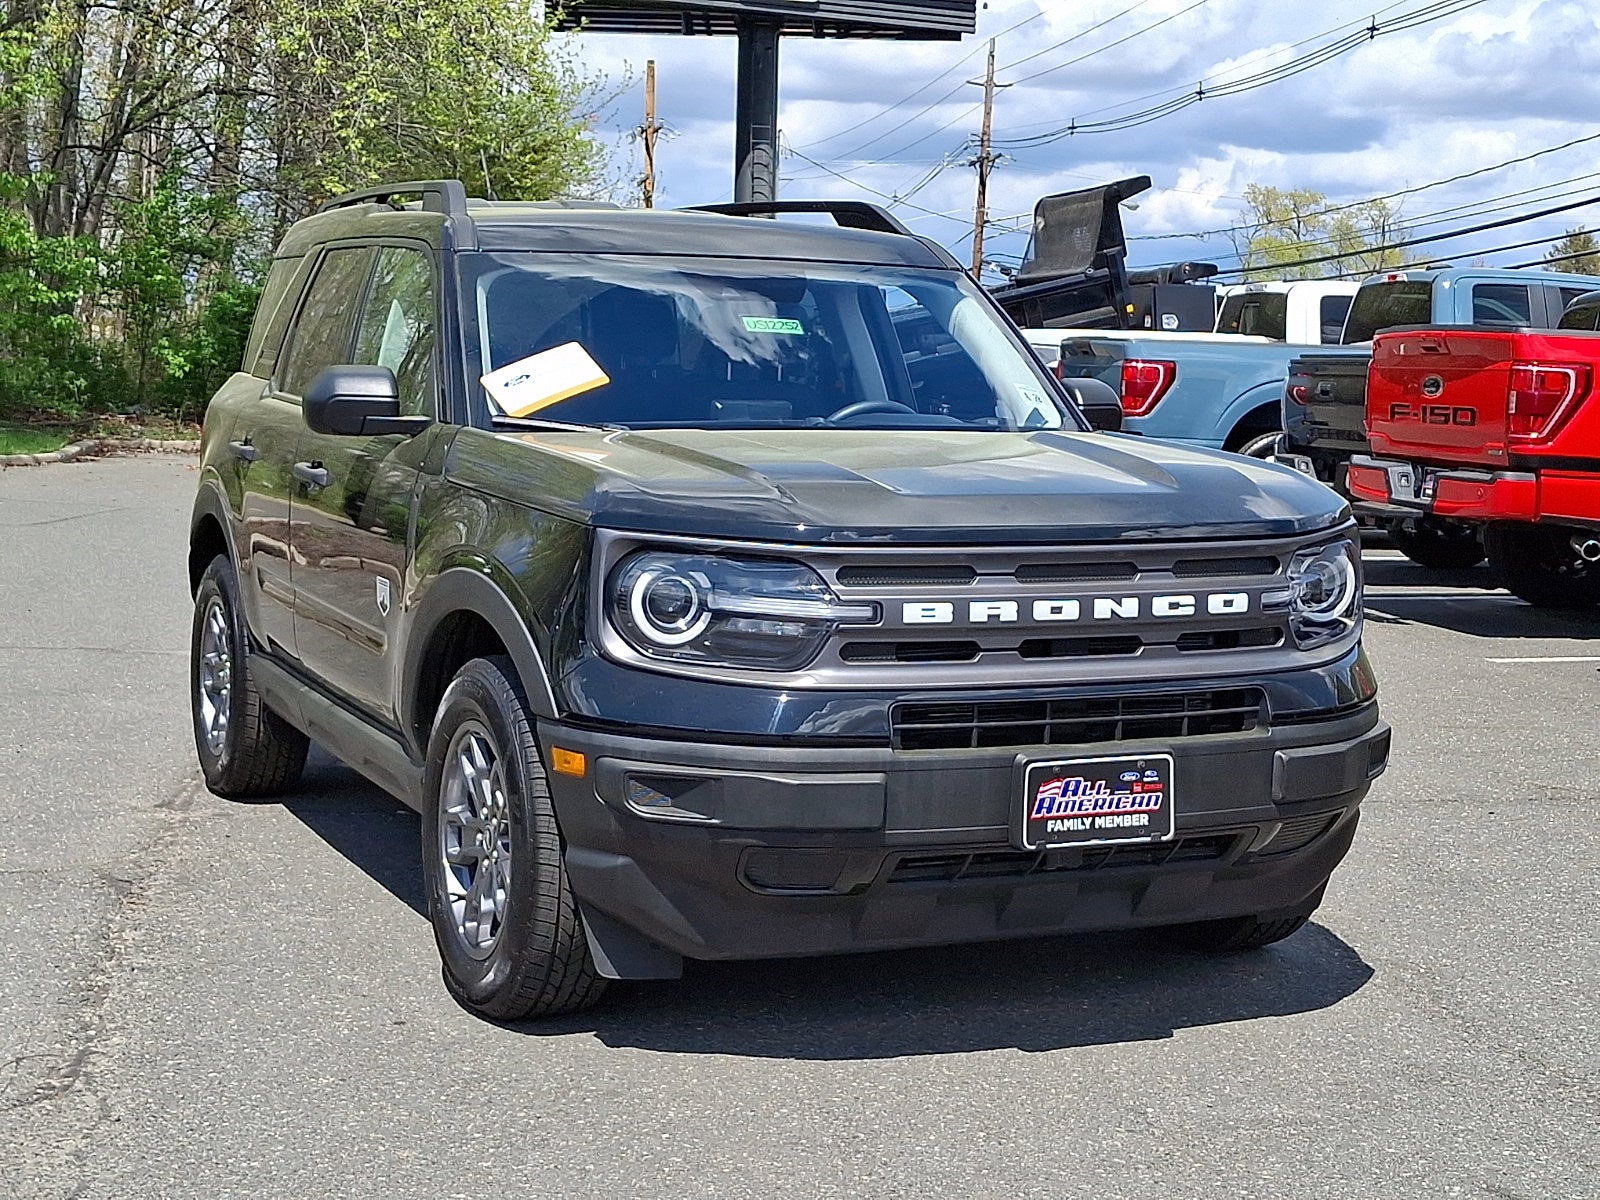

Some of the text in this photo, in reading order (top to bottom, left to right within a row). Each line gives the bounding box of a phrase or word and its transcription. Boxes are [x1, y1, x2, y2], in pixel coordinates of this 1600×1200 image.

[1389, 402, 1477, 427] F-150
[902, 592, 1249, 624] BRONCO
[1059, 777, 1111, 798] ALL
[1034, 793, 1163, 816] AMERICAN
[1047, 814, 1150, 832] FAMILY MEMBER
